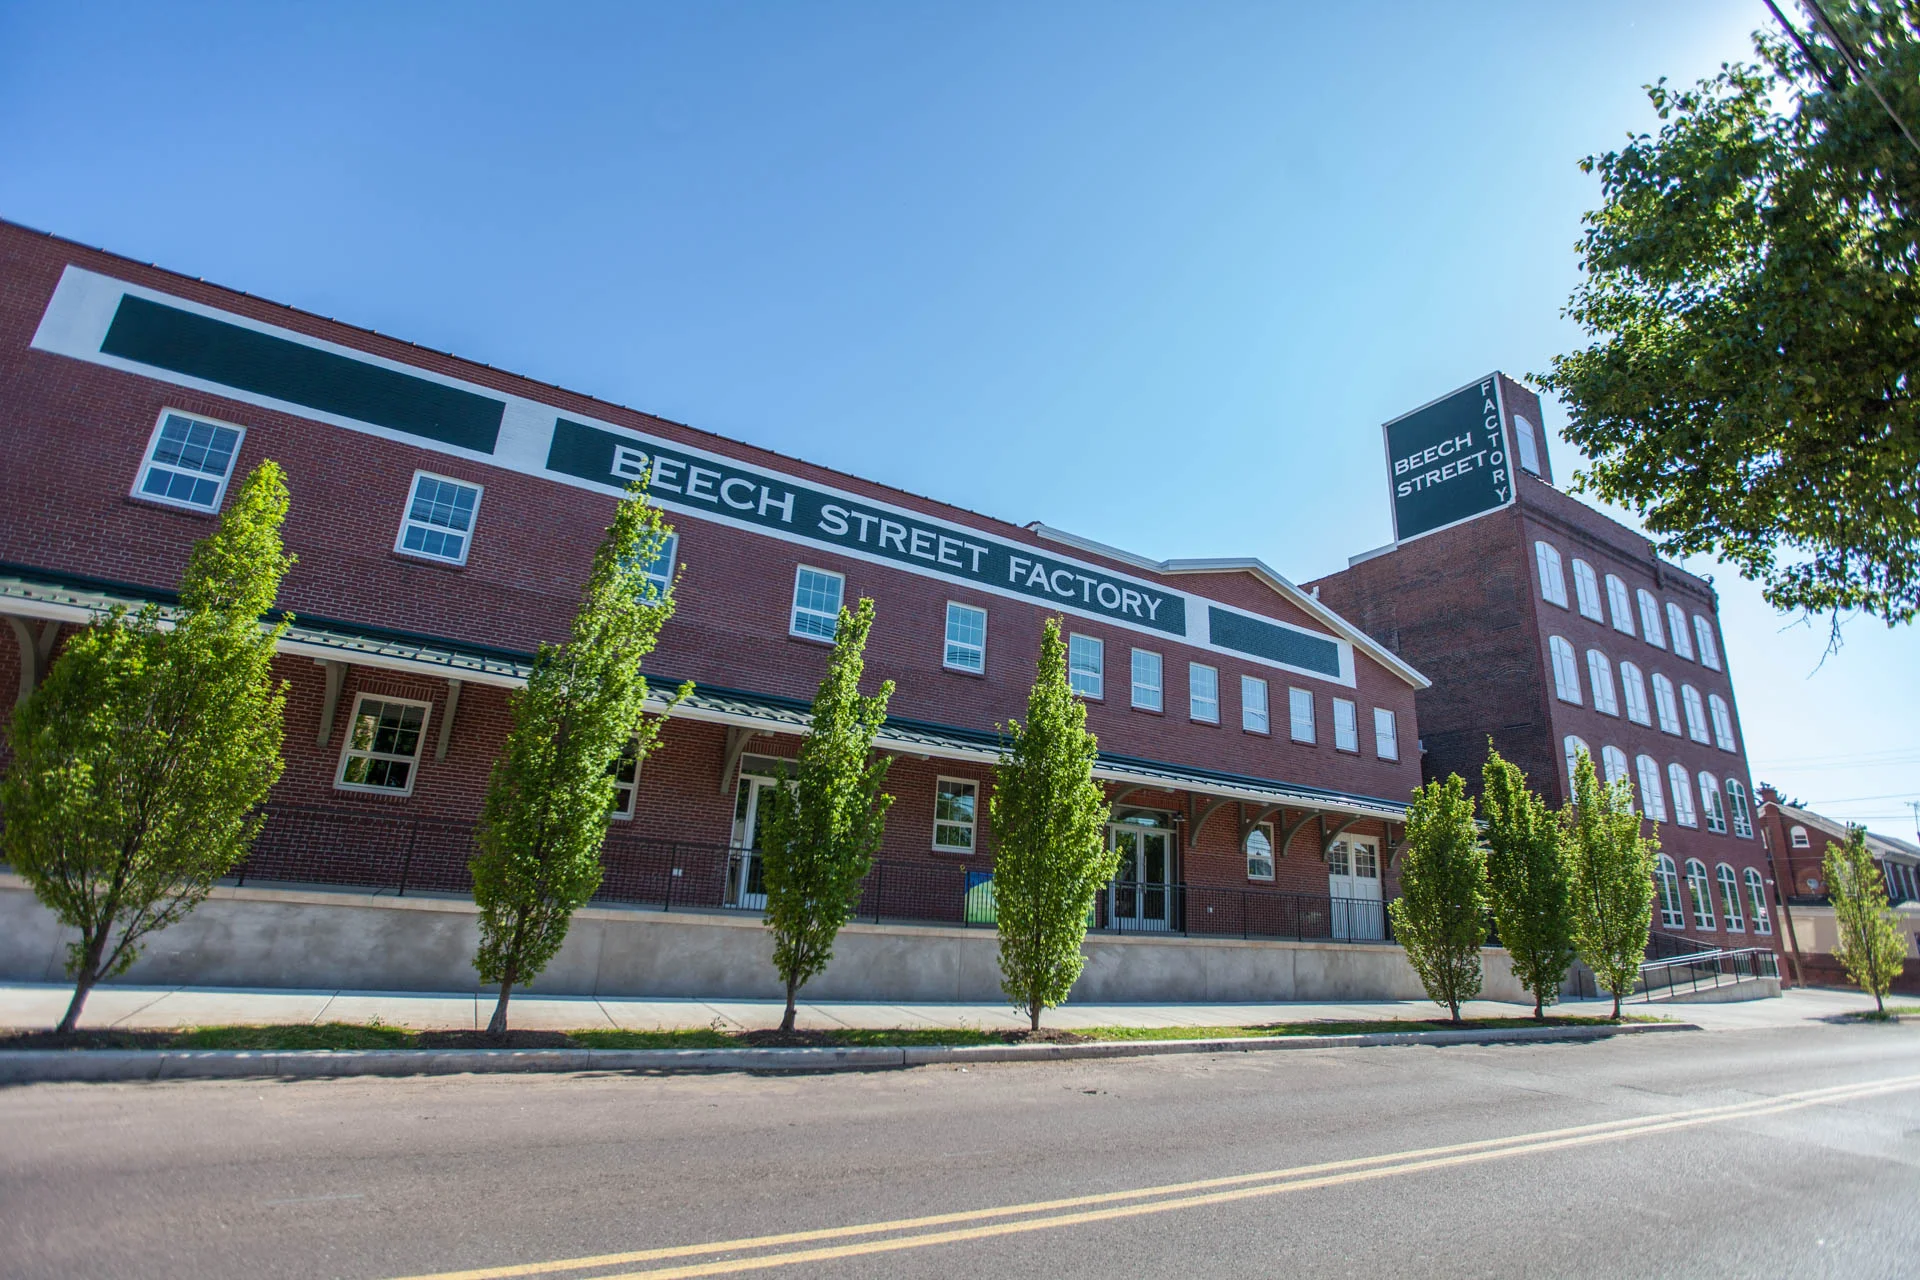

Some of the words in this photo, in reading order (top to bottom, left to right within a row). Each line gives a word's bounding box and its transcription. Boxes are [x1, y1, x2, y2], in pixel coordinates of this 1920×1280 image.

[1394, 432, 1472, 475] BEECH
[1397, 450, 1487, 497] STREET
[1481, 380, 1508, 502] FACTORY
[609, 443, 796, 522] BEECH
[818, 503, 989, 573] STREET
[1008, 555, 1163, 622] FACTORY
